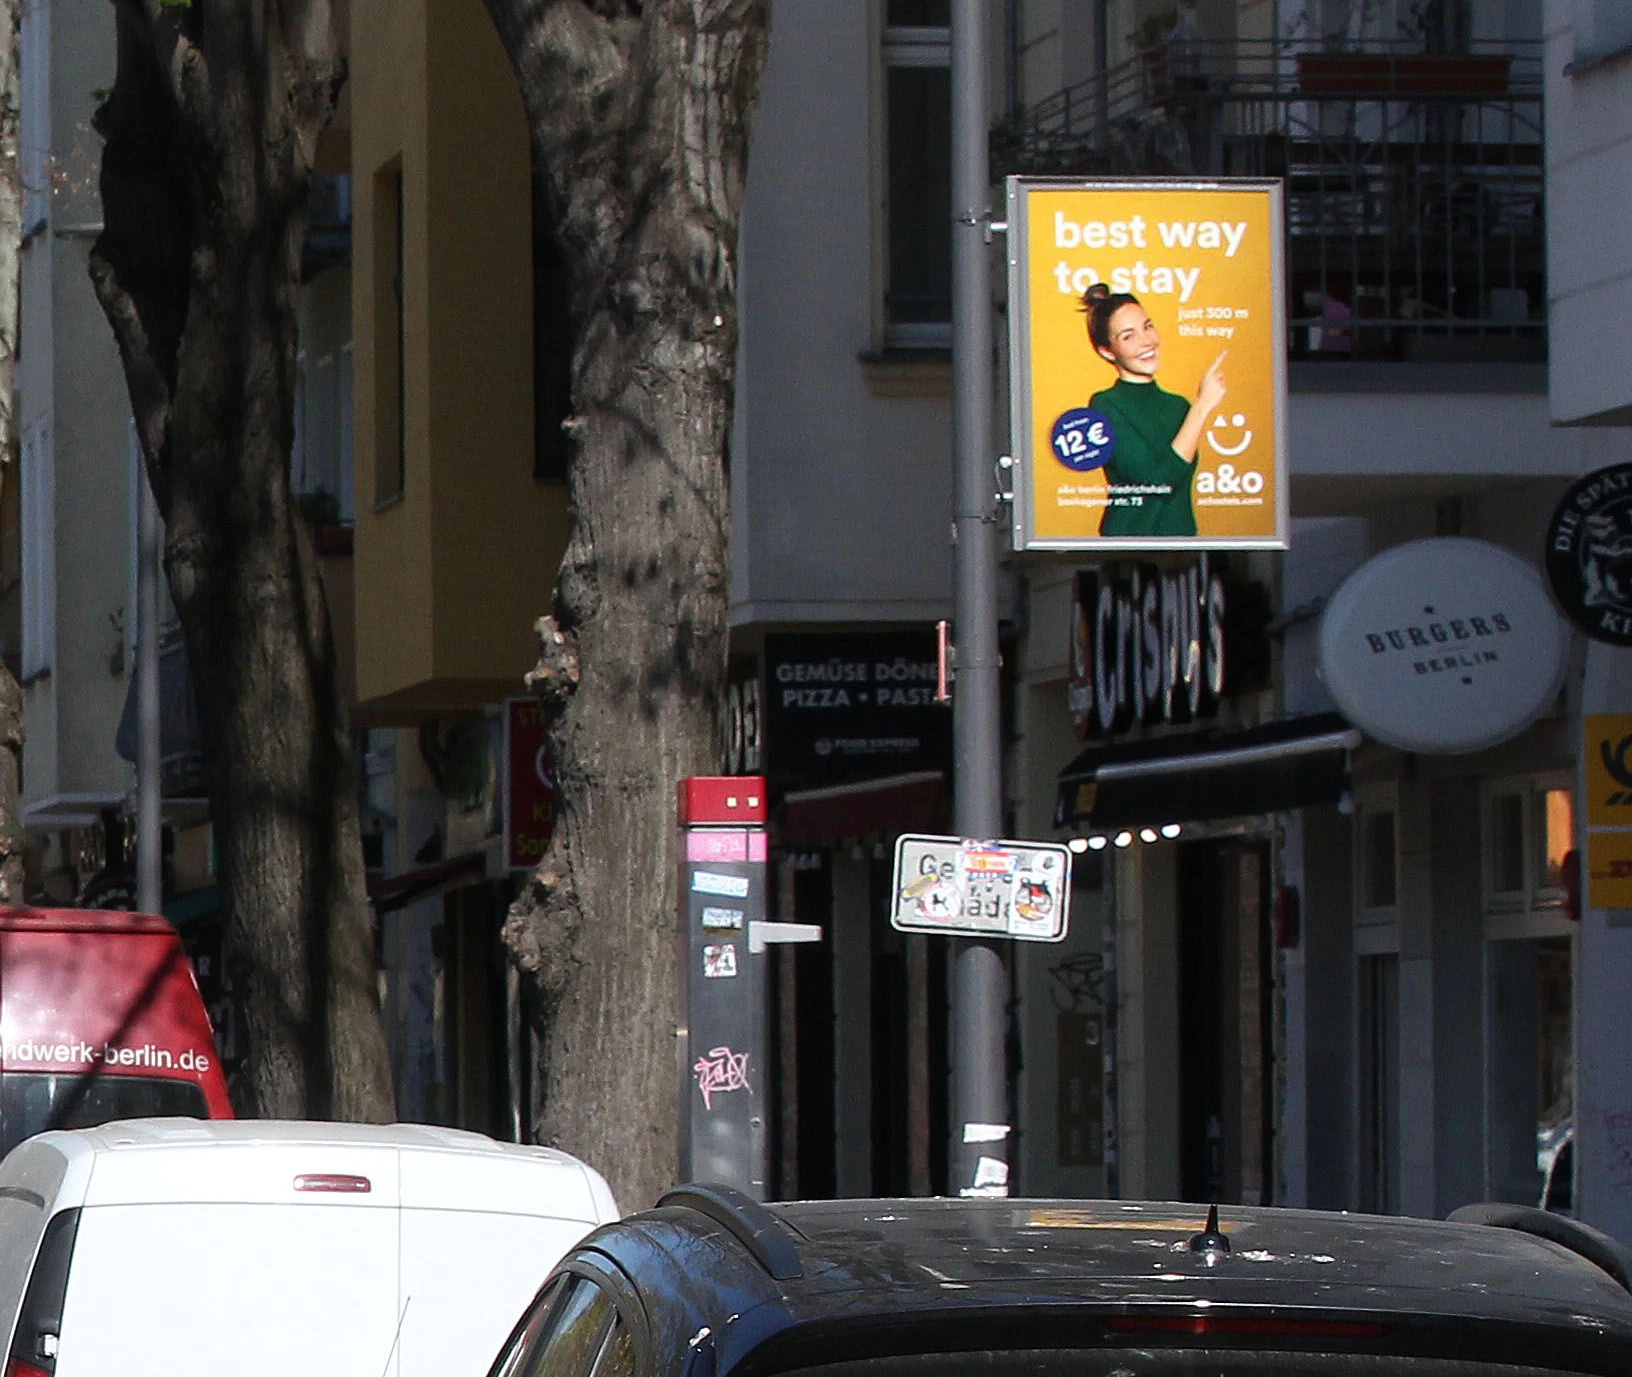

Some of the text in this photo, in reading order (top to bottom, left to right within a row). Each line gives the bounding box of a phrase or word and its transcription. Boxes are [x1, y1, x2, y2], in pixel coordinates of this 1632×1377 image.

[1054, 211, 1248, 257] best way
[1054, 261, 1201, 303] to stay
[1177, 306, 1204, 321] just
[1235, 309, 1249, 319] m
[1178, 323, 1234, 339] this way
[1055, 422, 1109, 457] 12 €
[1196, 464, 1264, 494] a&o
[1577, 472, 1632, 510] SPÄT
[1366, 613, 1512, 653] BURGERS
[776, 656, 940, 682] GEMÜSE DÖNE
[1413, 651, 1497, 674] BERLIN
[782, 687, 851, 708] PIZZA
